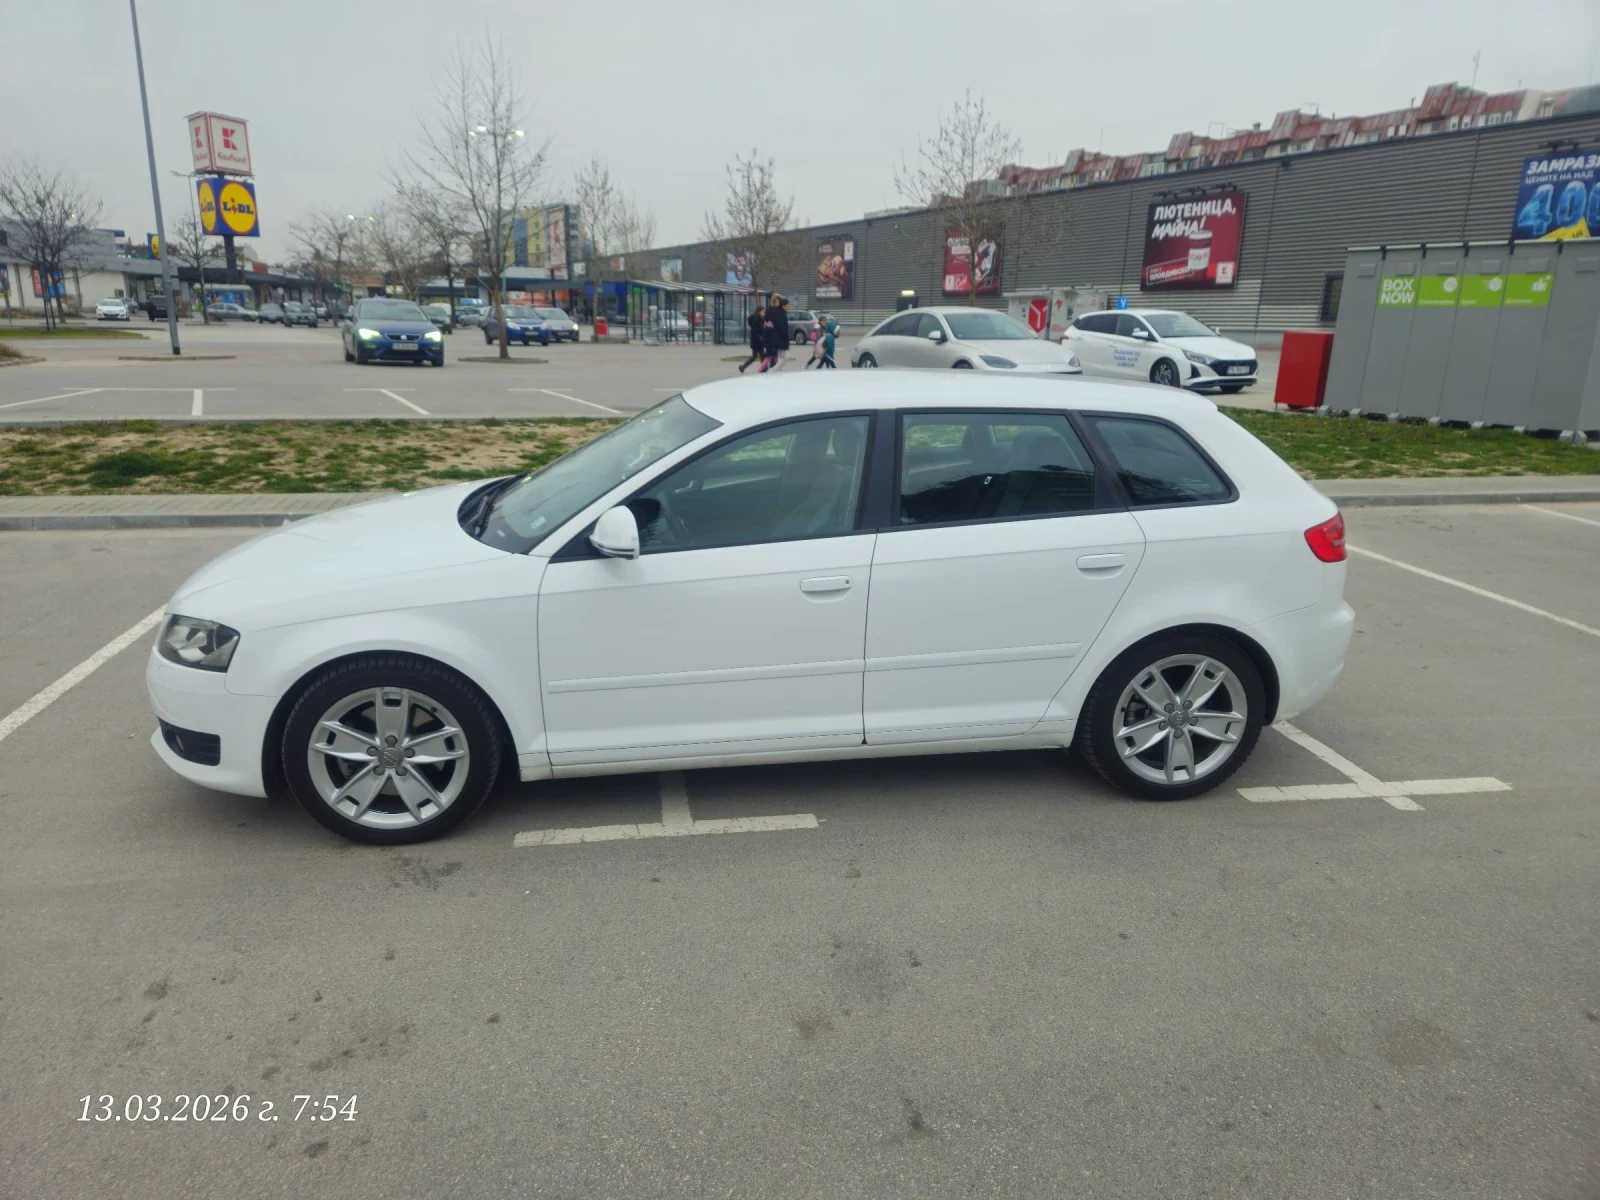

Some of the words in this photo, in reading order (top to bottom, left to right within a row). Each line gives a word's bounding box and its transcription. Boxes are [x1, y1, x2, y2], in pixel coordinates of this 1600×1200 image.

[217, 151, 247, 164] Kaufland
[1528, 155, 1600, 175] ЗАМРАЗ
[1525, 173, 1558, 184] ЦЕНИТЕ
[1560, 172, 1572, 181] НА
[1574, 169, 1594, 179] НАД
[1154, 198, 1237, 221] ЛЮТЕНИЦА,
[1152, 216, 1206, 240] МАЙНА!
[1382, 278, 1415, 291] BOX
[1380, 291, 1415, 305] NOW
